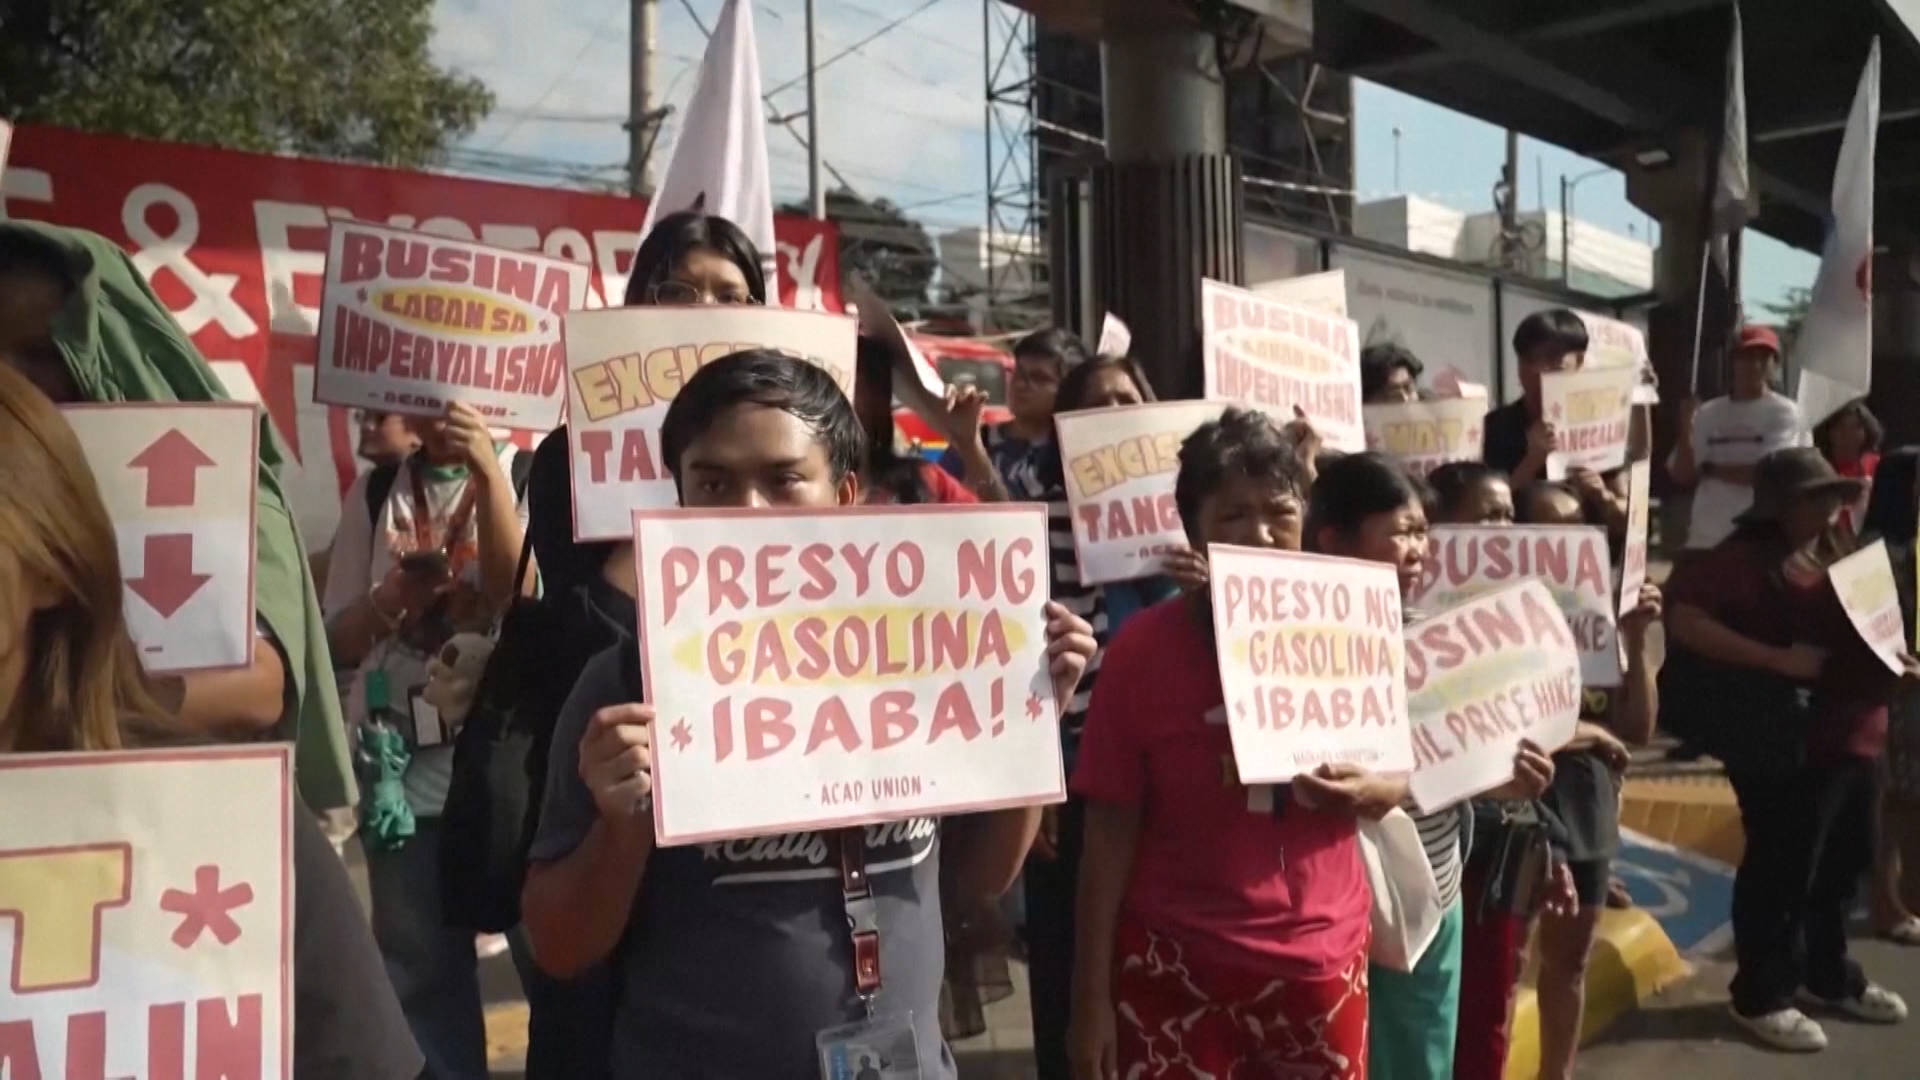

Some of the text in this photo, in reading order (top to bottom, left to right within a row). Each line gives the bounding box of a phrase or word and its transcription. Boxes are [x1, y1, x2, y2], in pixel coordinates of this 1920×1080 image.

[340, 231, 570, 317] BUSINA
[381, 292, 528, 333] LABAN SA
[332, 304, 564, 398] IMPERYALISMO
[1214, 294, 1351, 376] BUSINA
[660, 536, 1036, 627] PRESYO NG
[1224, 574, 1399, 634] PRESYO NG
[706, 607, 1012, 687] GASOLINA
[1249, 629, 1394, 677] GASOLINA
[712, 676, 1006, 763] IBABA!
[1253, 684, 1397, 731] IBABA!
[1445, 684, 1536, 752] PRICE
[1532, 665, 1576, 718] HIKE
[820, 775, 922, 807] ACAD UNION
